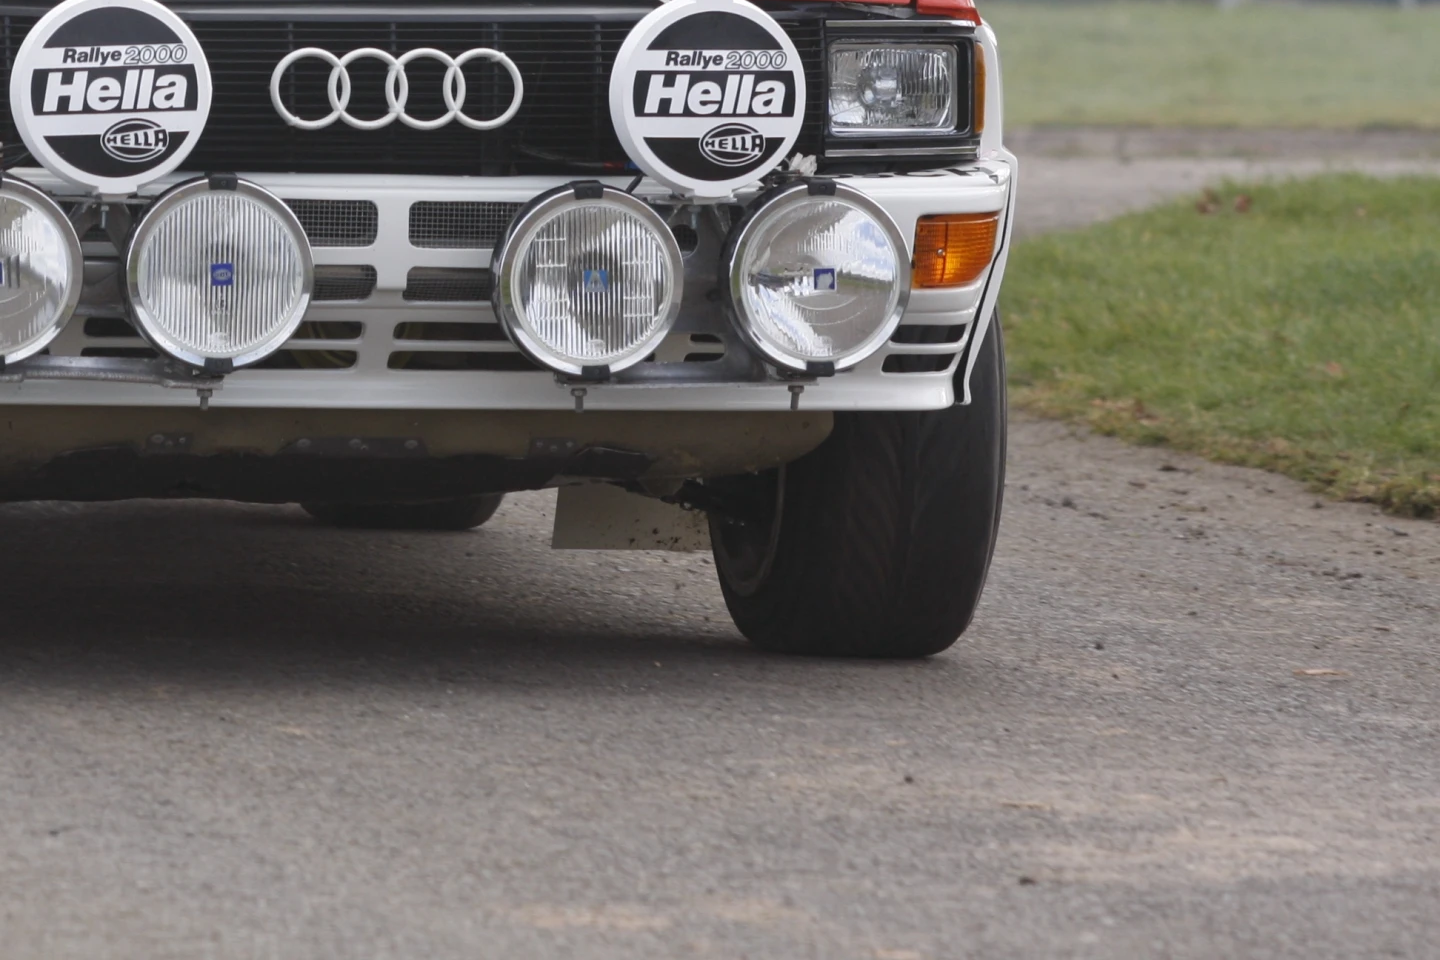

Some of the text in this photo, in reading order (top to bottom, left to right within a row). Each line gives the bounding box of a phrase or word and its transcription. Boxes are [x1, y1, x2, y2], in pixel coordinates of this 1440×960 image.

[62, 44, 188, 65] Rallye 2000
[665, 50, 788, 70] Rallye 2000
[42, 69, 188, 113] Hella
[643, 73, 787, 115] Hella
[105, 127, 169, 148] HELLA
[703, 134, 765, 154] HELLA
